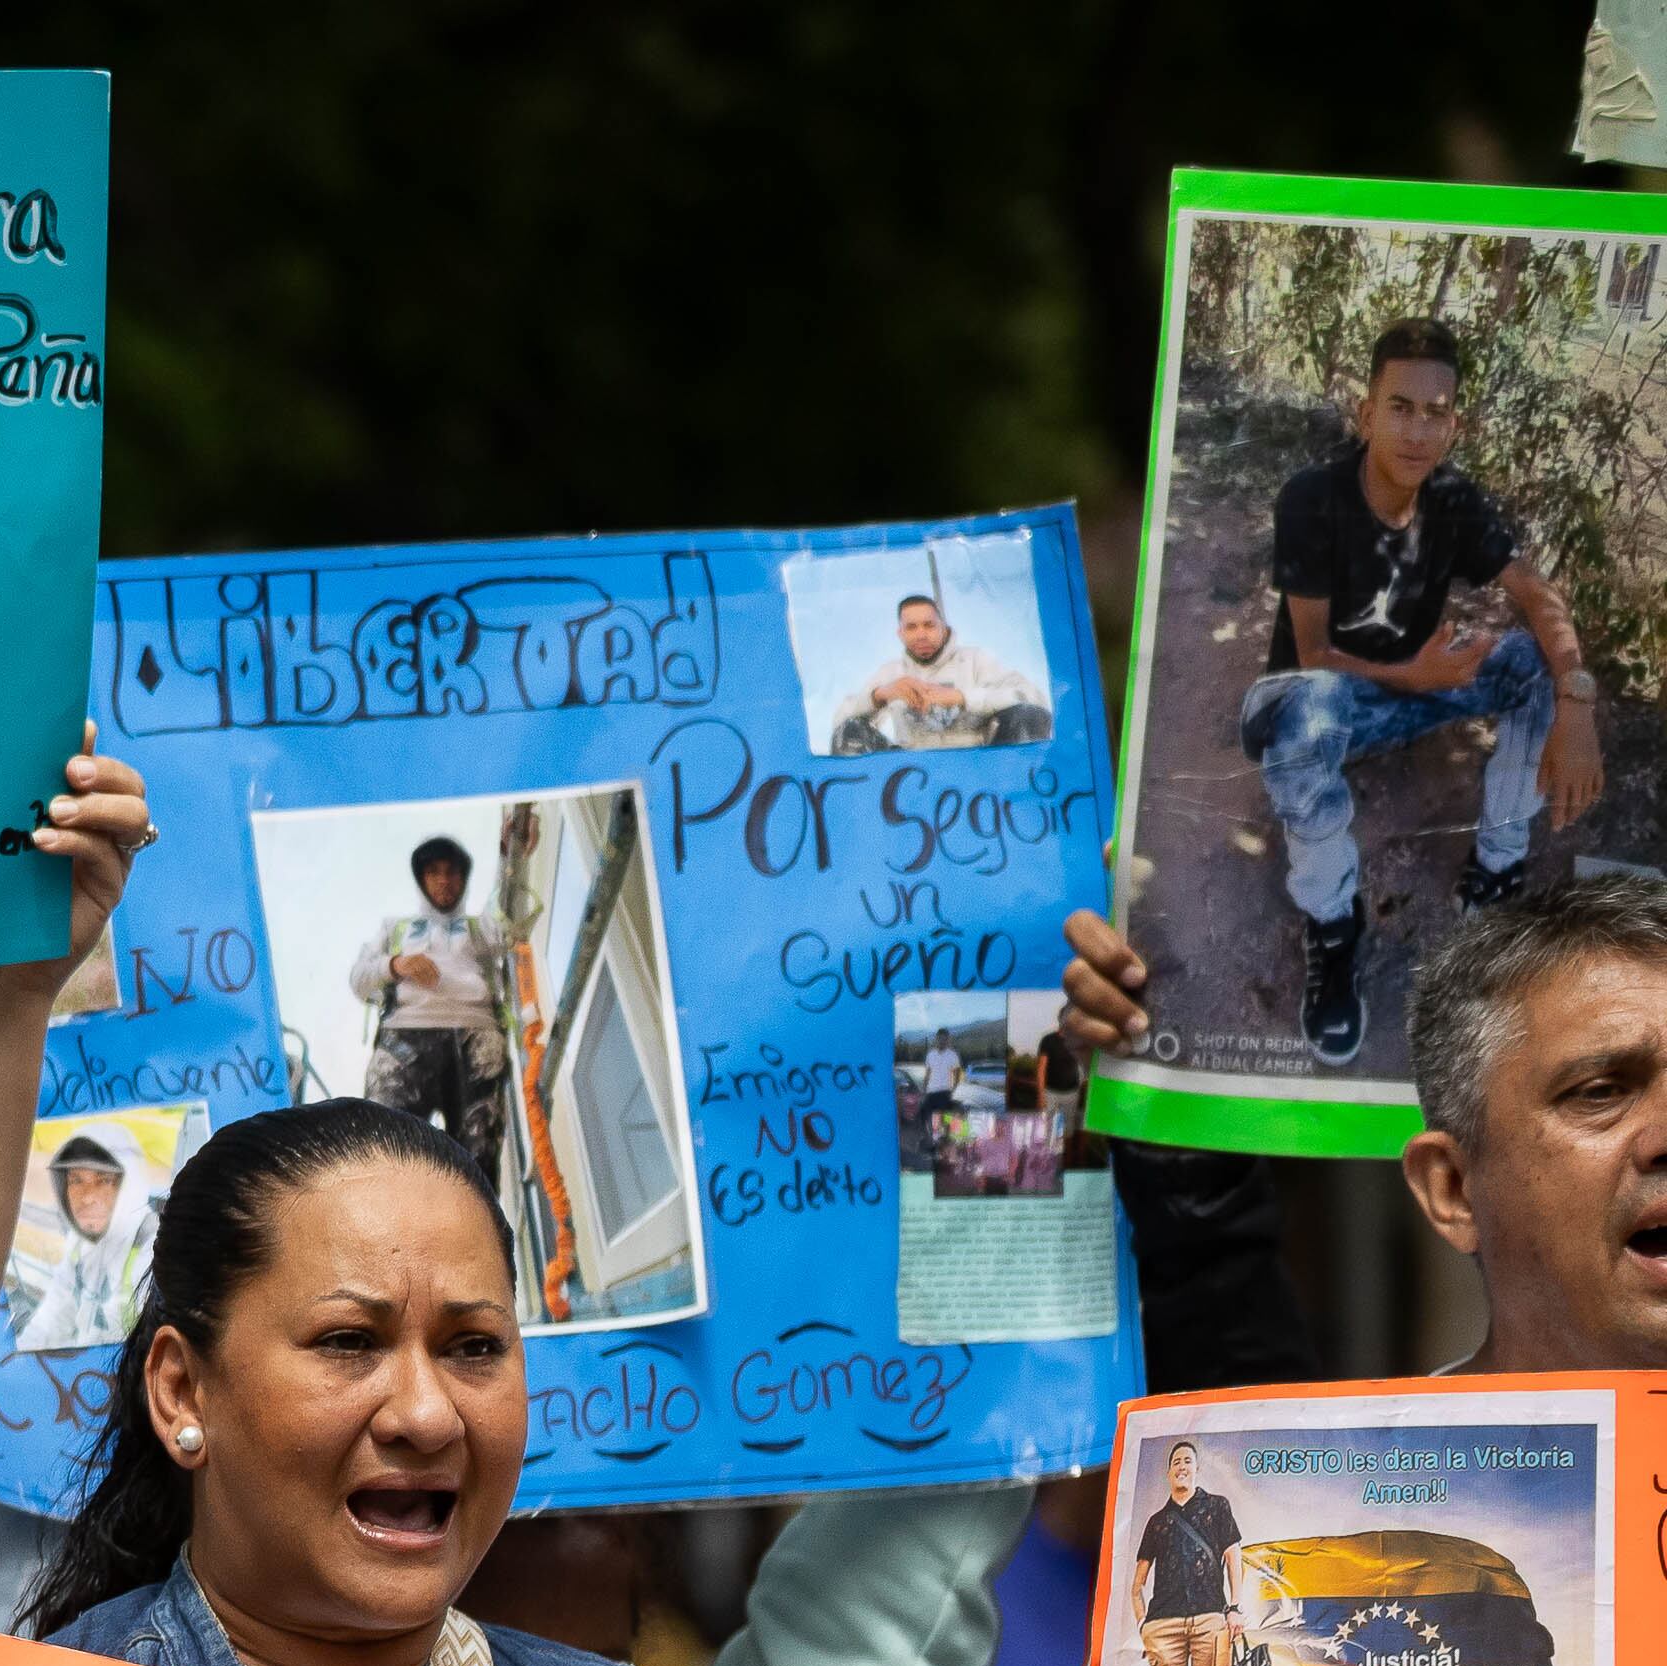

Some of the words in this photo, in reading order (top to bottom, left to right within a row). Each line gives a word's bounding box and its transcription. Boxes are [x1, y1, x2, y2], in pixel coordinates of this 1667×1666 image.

[649, 717, 867, 877] Por
[881, 765, 1096, 876] Seguir
[126, 926, 257, 1020] NO
[780, 926, 1017, 1013] Sueño
[1244, 1448, 1342, 1474] CRISTO
[1347, 1447, 1379, 1472] les
[1383, 1445, 1438, 1471] dara
[1444, 1446, 1467, 1470] la
[1473, 1444, 1575, 1470] Victoria
[1362, 1480, 1449, 1505] Amen!!
